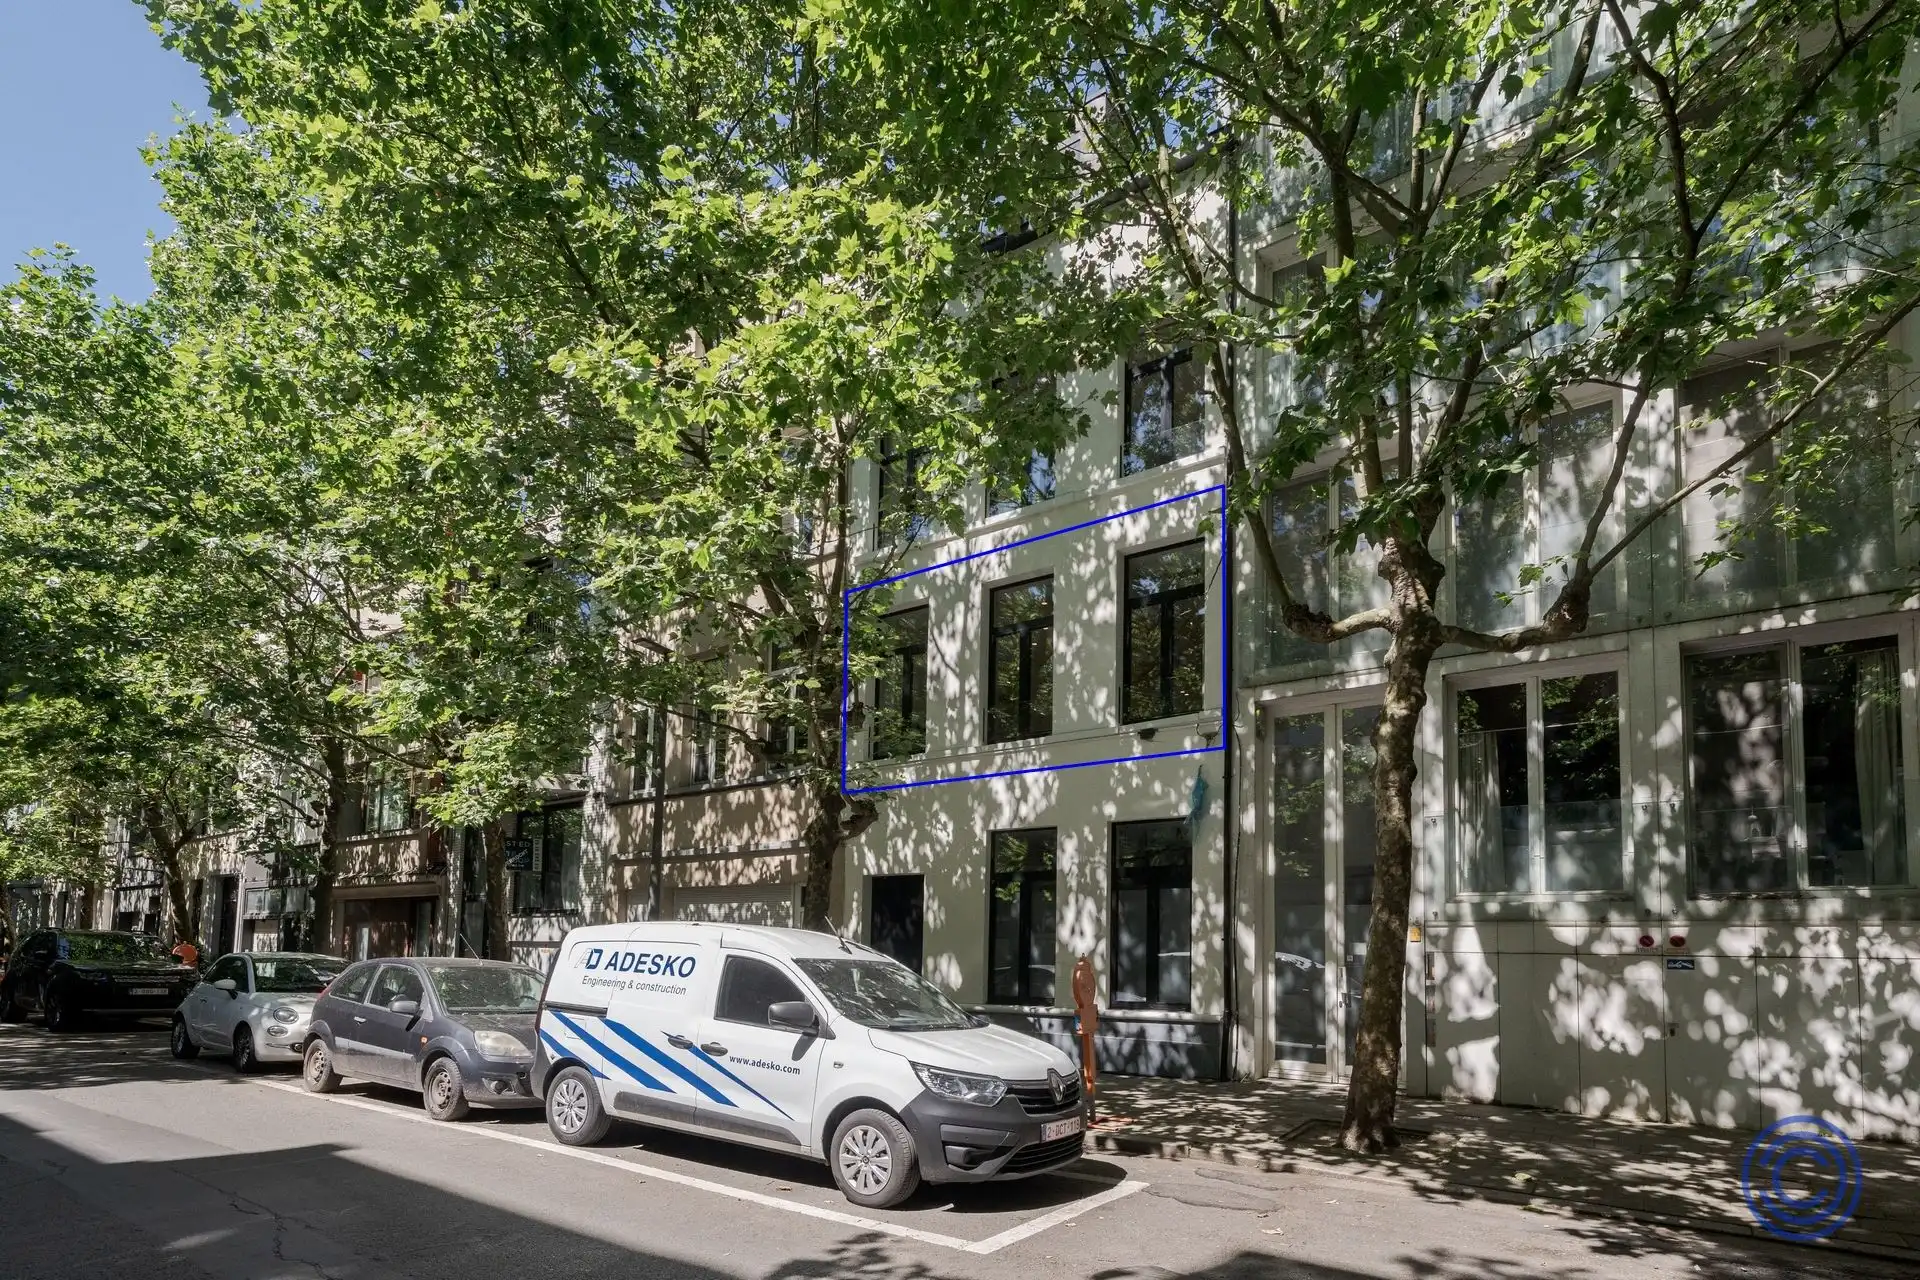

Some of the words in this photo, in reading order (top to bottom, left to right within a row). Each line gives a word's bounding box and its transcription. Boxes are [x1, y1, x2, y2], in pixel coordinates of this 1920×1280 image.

[604, 951, 696, 978] ADESKO
[582, 975, 626, 990] Engineering
[628, 980, 634, 989] &
[636, 981, 687, 995] construction
[729, 1055, 800, 1075] www.adesko.com
